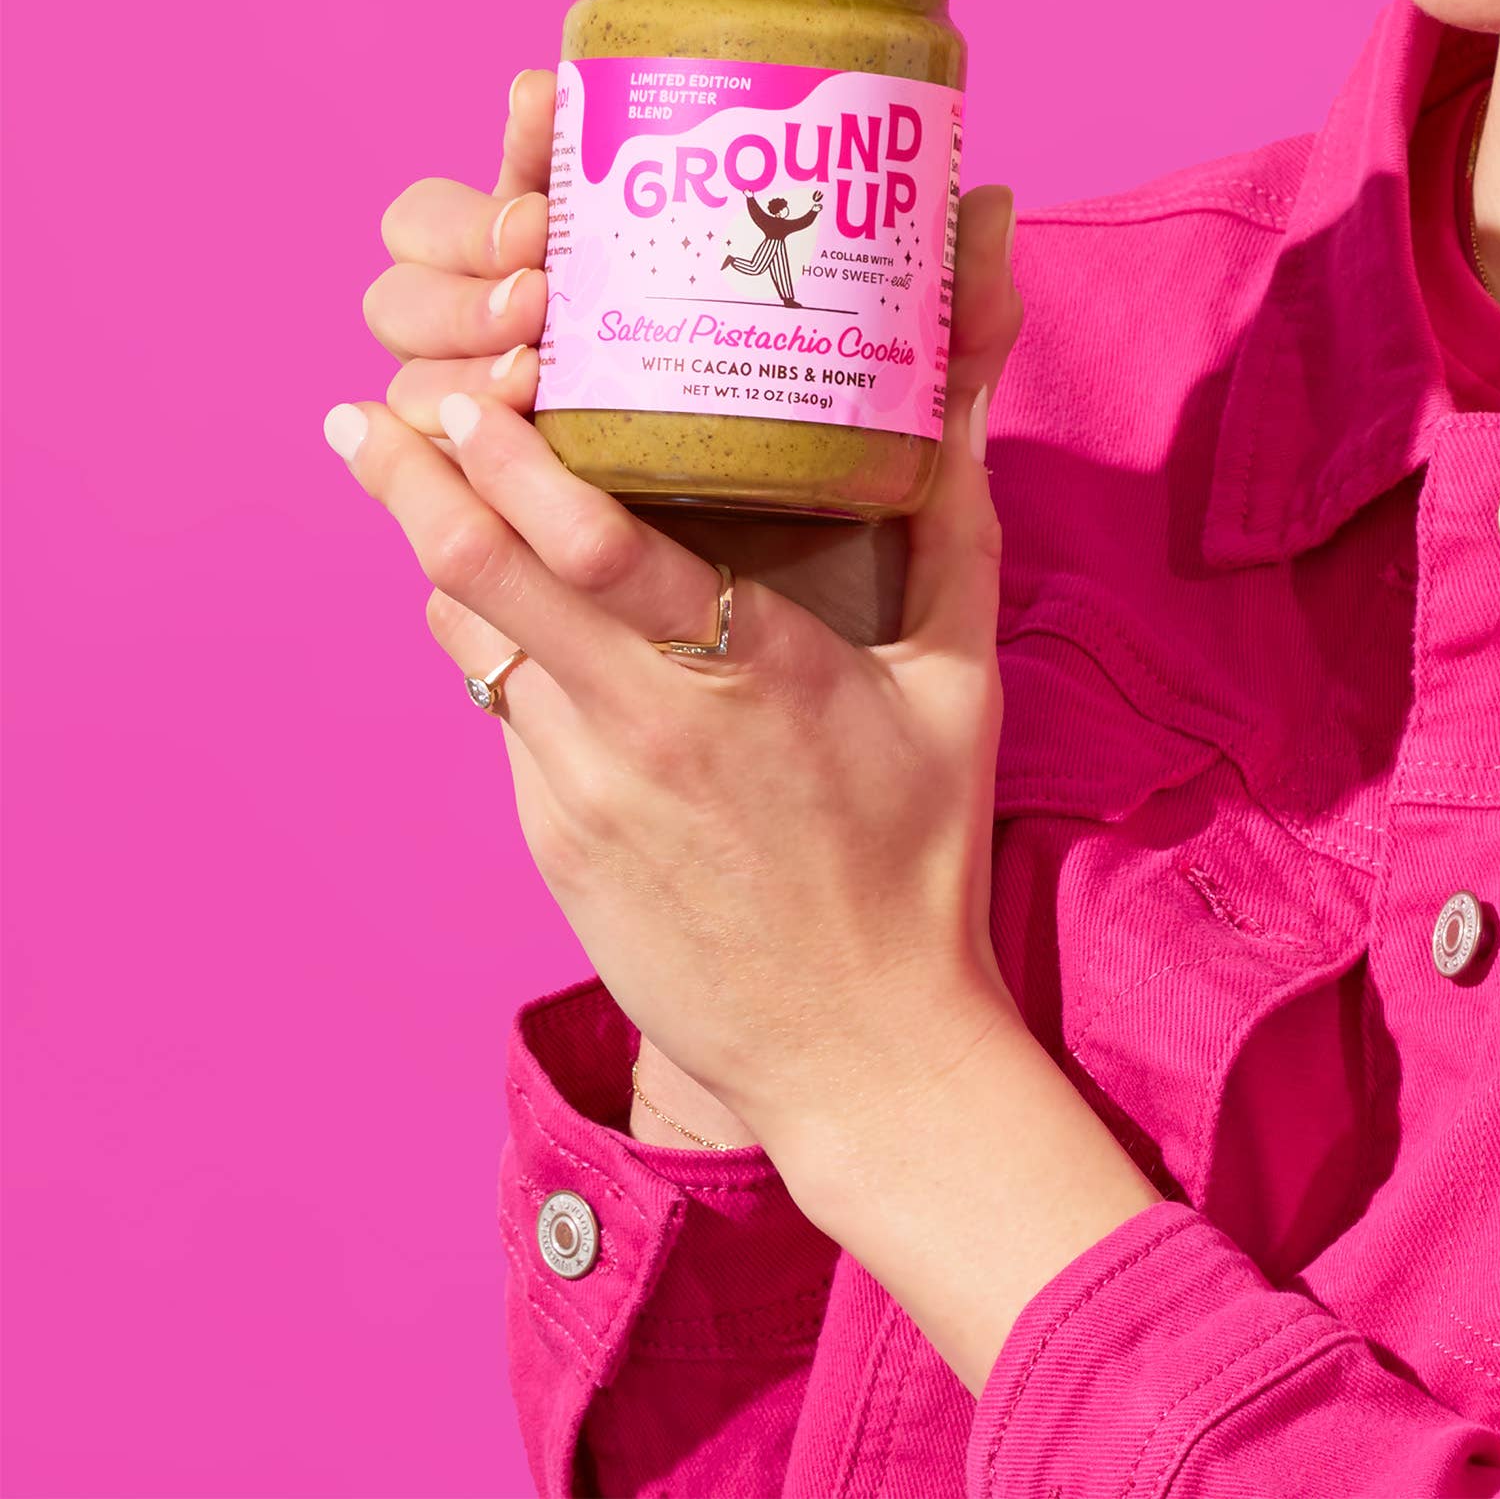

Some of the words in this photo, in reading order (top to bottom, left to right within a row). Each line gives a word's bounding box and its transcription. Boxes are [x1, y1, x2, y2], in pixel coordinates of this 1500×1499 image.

[630, 72, 685, 87] LIMITED
[689, 74, 752, 91] EDITION
[629, 90, 657, 103] NUT
[659, 90, 717, 105] BUTTER
[628, 105, 673, 120] BLEND
[623, 103, 922, 218] GROUND
[836, 170, 917, 240] UP
[821, 250, 828, 259] A
[830, 250, 869, 263] COLLAB
[870, 255, 894, 267] WITH
[802, 265, 838, 279] HOW
[598, 310, 687, 343] Salted
[689, 314, 833, 356] Pistachio
[837, 326, 915, 366] Cookie
[641, 356, 685, 373] WITH
[691, 358, 752, 377] CACAO
[759, 364, 798, 381] NIBS
[804, 368, 816, 383] &
[822, 369, 877, 389] HONEY
[683, 384, 709, 397] NET
[714, 386, 740, 400] WT.
[746, 388, 759, 401] 12
[764, 390, 784, 403] OZ
[788, 391, 833, 409] (340g)
